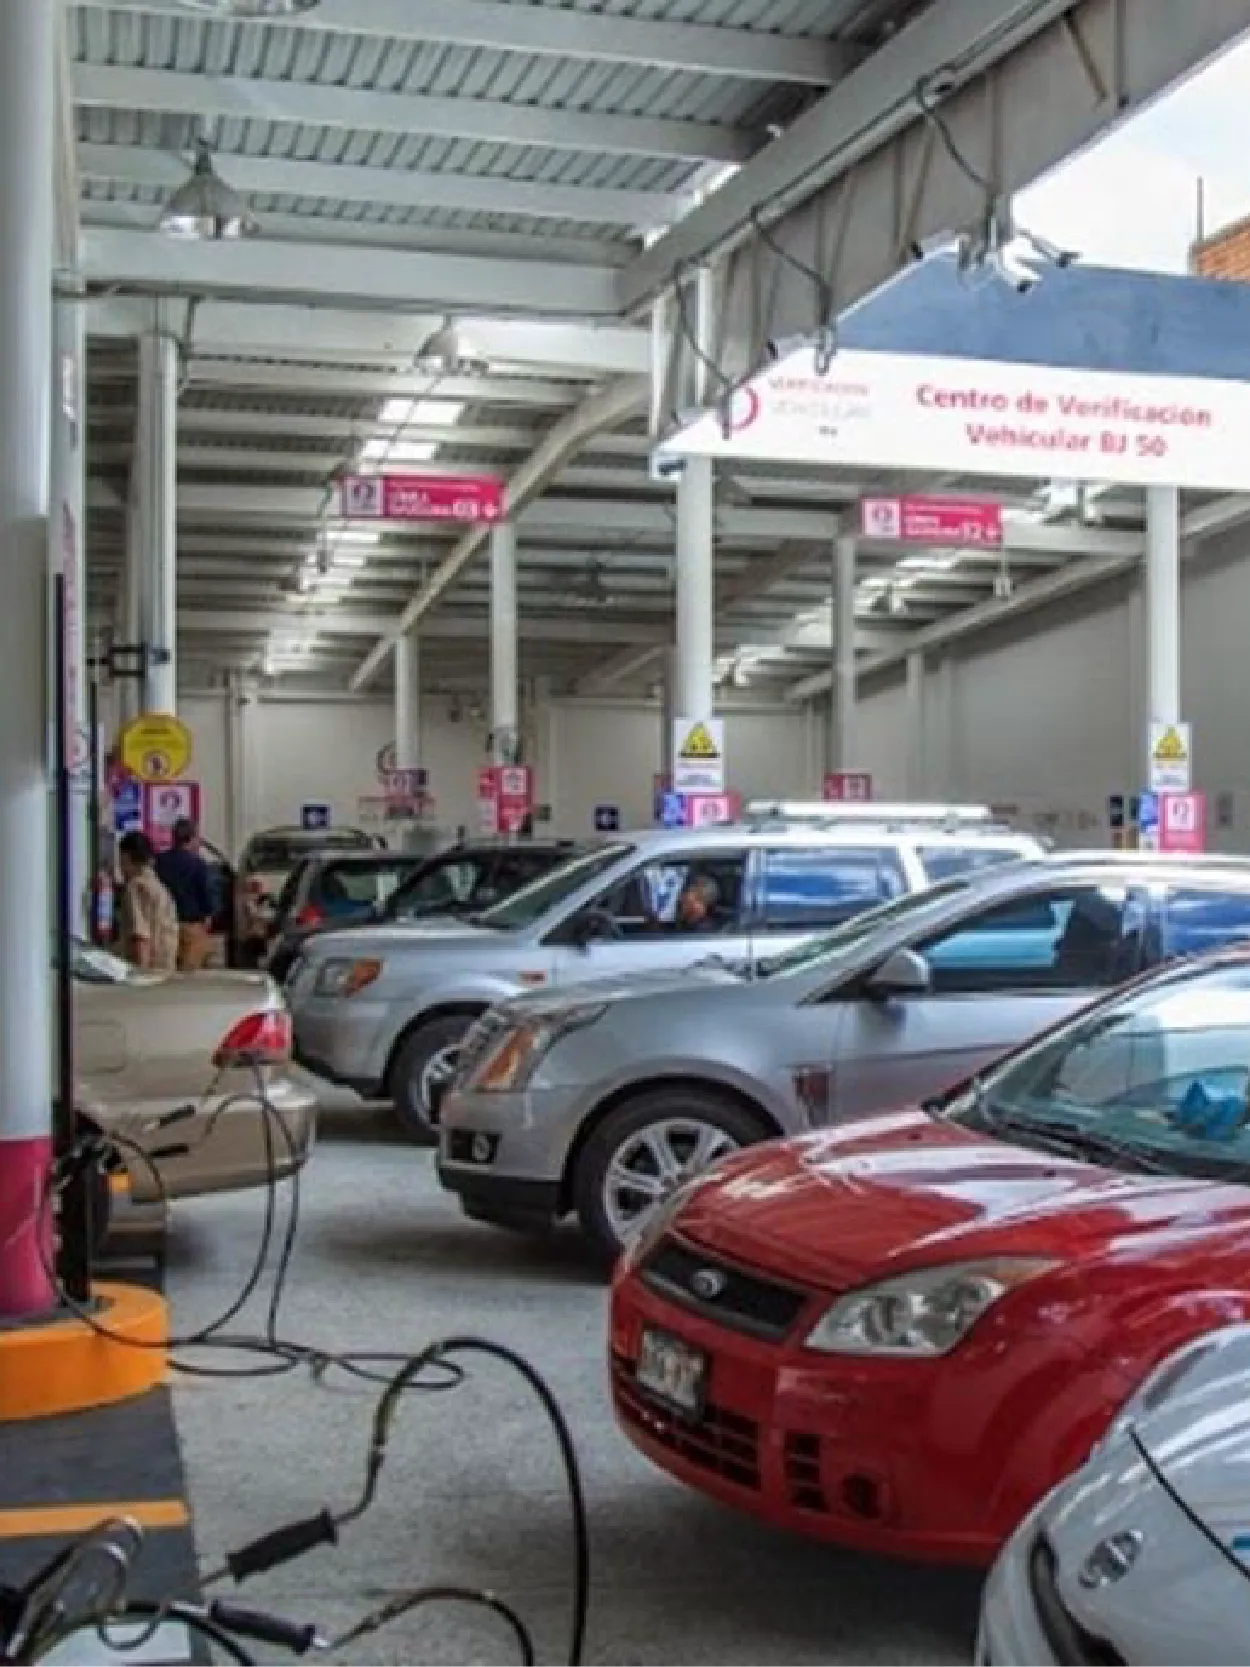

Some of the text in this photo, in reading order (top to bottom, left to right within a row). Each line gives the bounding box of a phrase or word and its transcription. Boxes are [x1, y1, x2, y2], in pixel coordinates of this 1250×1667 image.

[916, 384, 1009, 412] Centro
[1015, 389, 1049, 413] de
[964, 423, 1090, 451] Vehicular
[1136, 434, 1169, 457] 50
